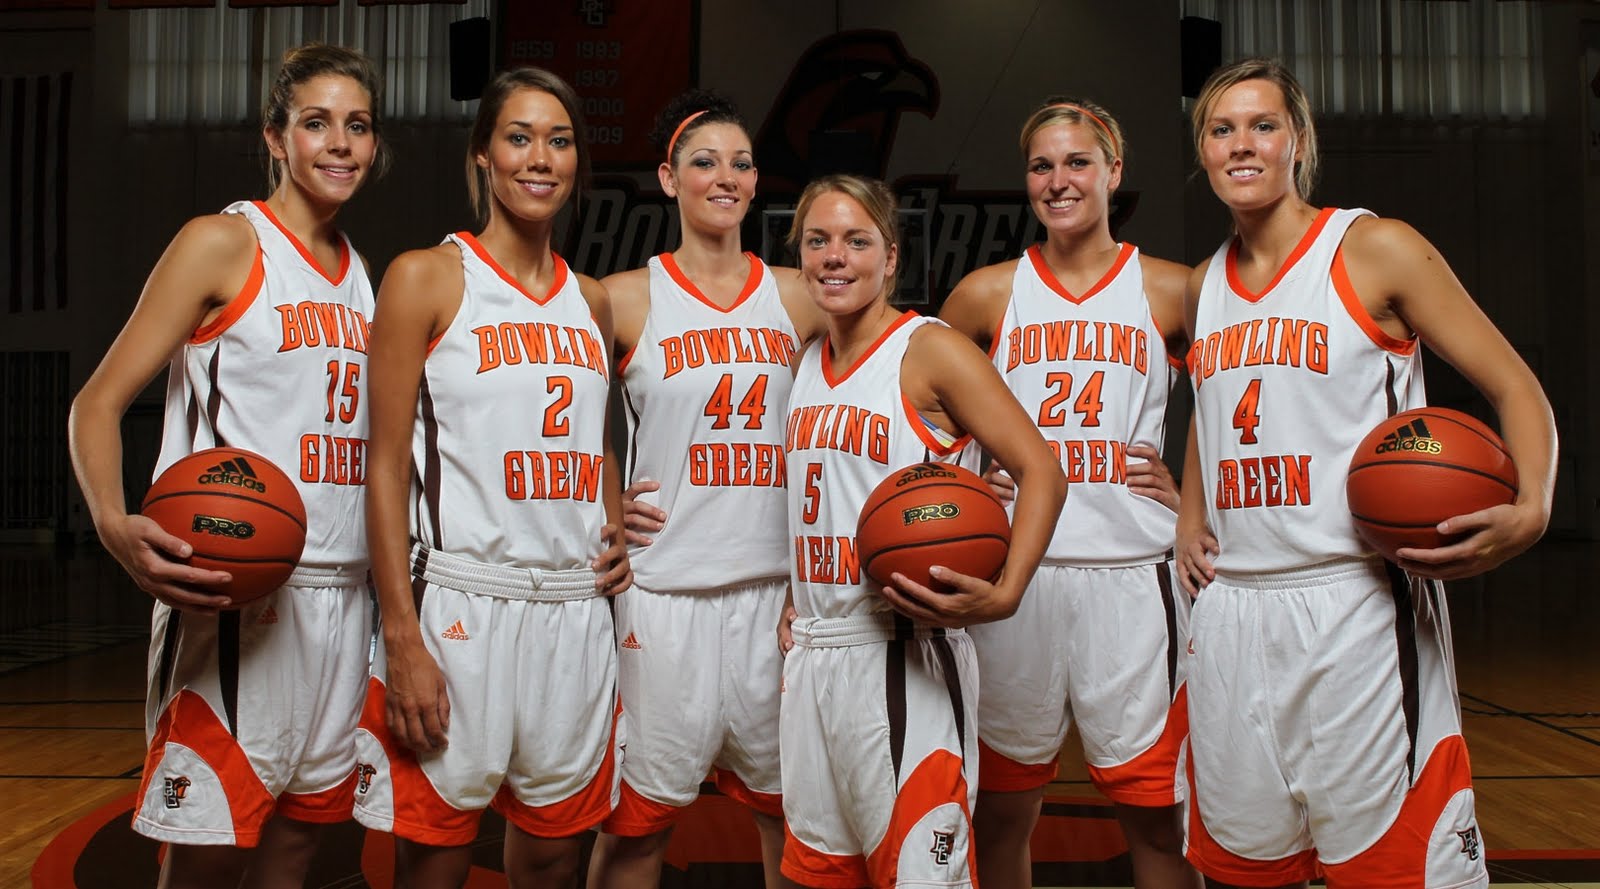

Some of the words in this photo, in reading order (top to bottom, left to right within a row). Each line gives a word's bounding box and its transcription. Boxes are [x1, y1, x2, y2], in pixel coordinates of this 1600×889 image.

[576, 40, 623, 59] 1983
[580, 97, 624, 116] 000
[585, 126, 624, 144] 009
[273, 300, 373, 355] BOWLIN
[470, 321, 609, 386] BOWLIN
[1005, 320, 1148, 377] BOWLING
[325, 360, 361, 424] 15
[541, 375, 574, 438] 2
[703, 373, 769, 430] 44
[1037, 371, 1106, 428] 24
[1232, 378, 1263, 445] 4
[300, 434, 370, 486] GREE
[785, 404, 890, 466] OWLING
[1375, 437, 1443, 455] adidas
[198, 472, 267, 494] adidas
[503, 450, 605, 503] GREN
[802, 462, 823, 525] 5
[895, 469, 958, 487] adidas
[1215, 455, 1312, 510] REEN
[191, 513, 256, 540] PRO
[902, 502, 960, 527] PRO
